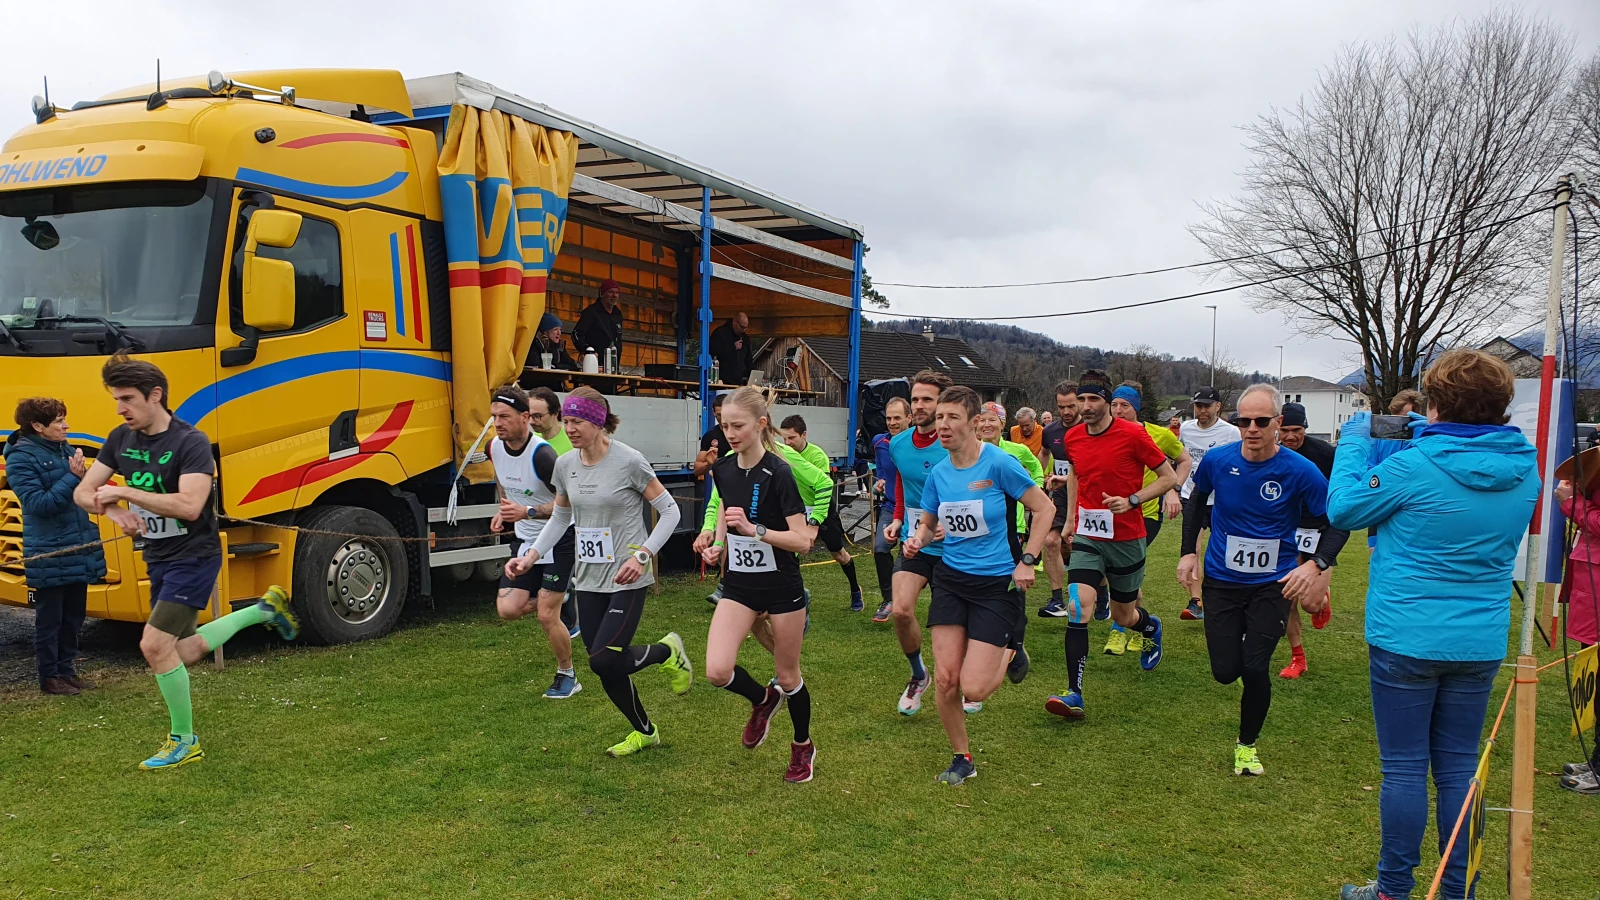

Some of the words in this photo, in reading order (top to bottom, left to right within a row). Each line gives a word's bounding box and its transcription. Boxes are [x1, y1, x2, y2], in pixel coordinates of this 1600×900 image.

[141, 516, 167, 533] 07
[945, 514, 978, 532] 380
[1083, 518, 1109, 534] 414
[580, 540, 604, 558] 381
[734, 548, 767, 568] 382
[1232, 549, 1270, 569] 410
[28, 592, 36, 603] FL
[1077, 662, 1086, 690] CRAFT
